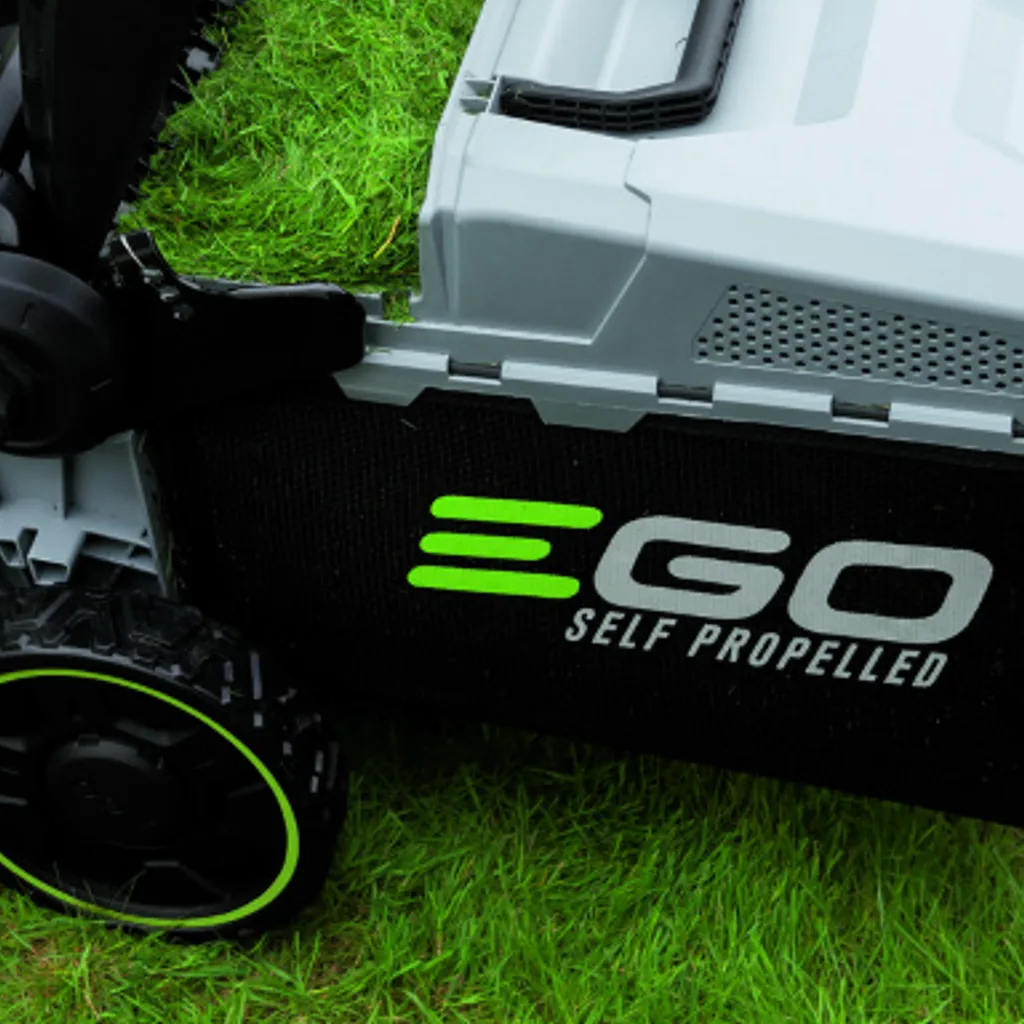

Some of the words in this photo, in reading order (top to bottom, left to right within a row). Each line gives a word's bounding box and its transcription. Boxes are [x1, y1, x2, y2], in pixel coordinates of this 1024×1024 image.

[407, 494, 994, 644] EGO
[565, 607, 677, 651] SELF
[687, 623, 948, 689] PROPELLED
